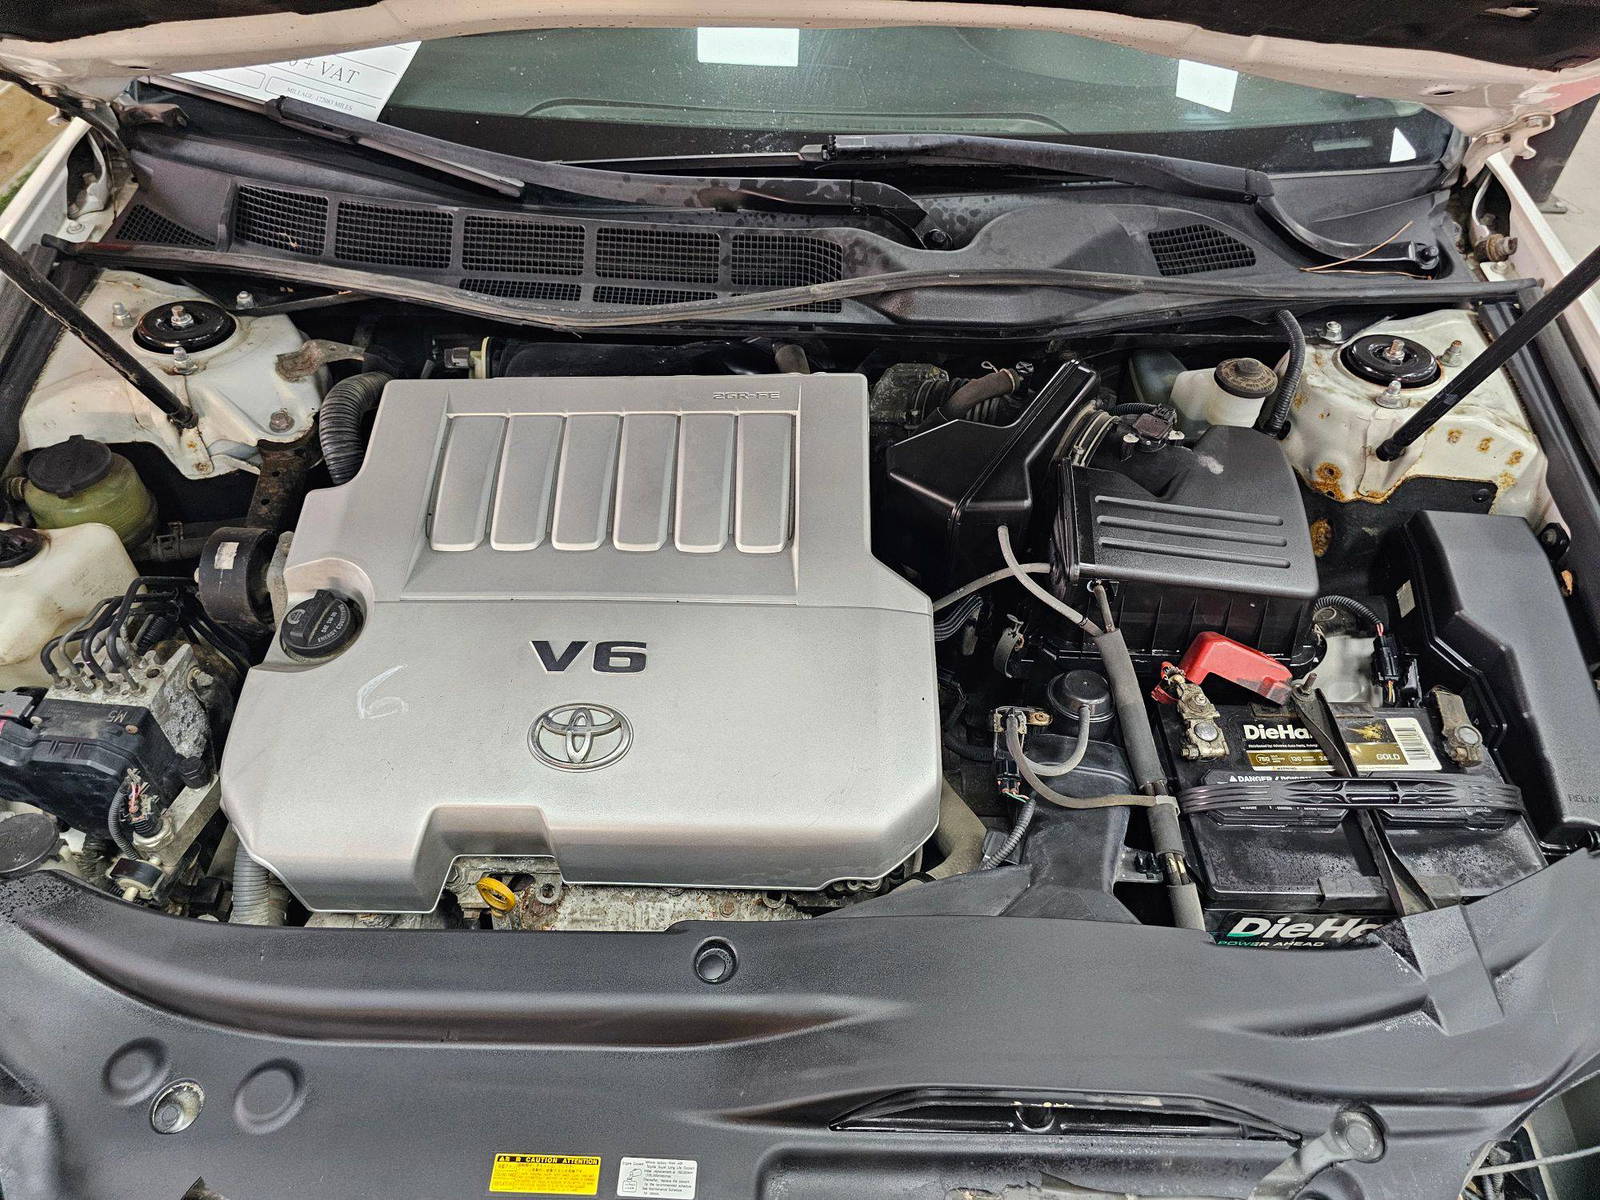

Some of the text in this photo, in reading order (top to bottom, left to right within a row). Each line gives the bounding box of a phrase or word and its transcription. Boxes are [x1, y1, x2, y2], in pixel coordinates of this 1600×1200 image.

[320, 61, 360, 83] VAT
[712, 391, 780, 400] 2GR-FE
[530, 640, 647, 674] V6
[356, 664, 408, 719] 6
[1243, 723, 1313, 740] DieHa
[1375, 753, 1401, 761] GOLD
[1272, 940, 1326, 948] AHEAD
[525, 1156, 558, 1164] CAUTION
[562, 1157, 598, 1165] ATTENTION
